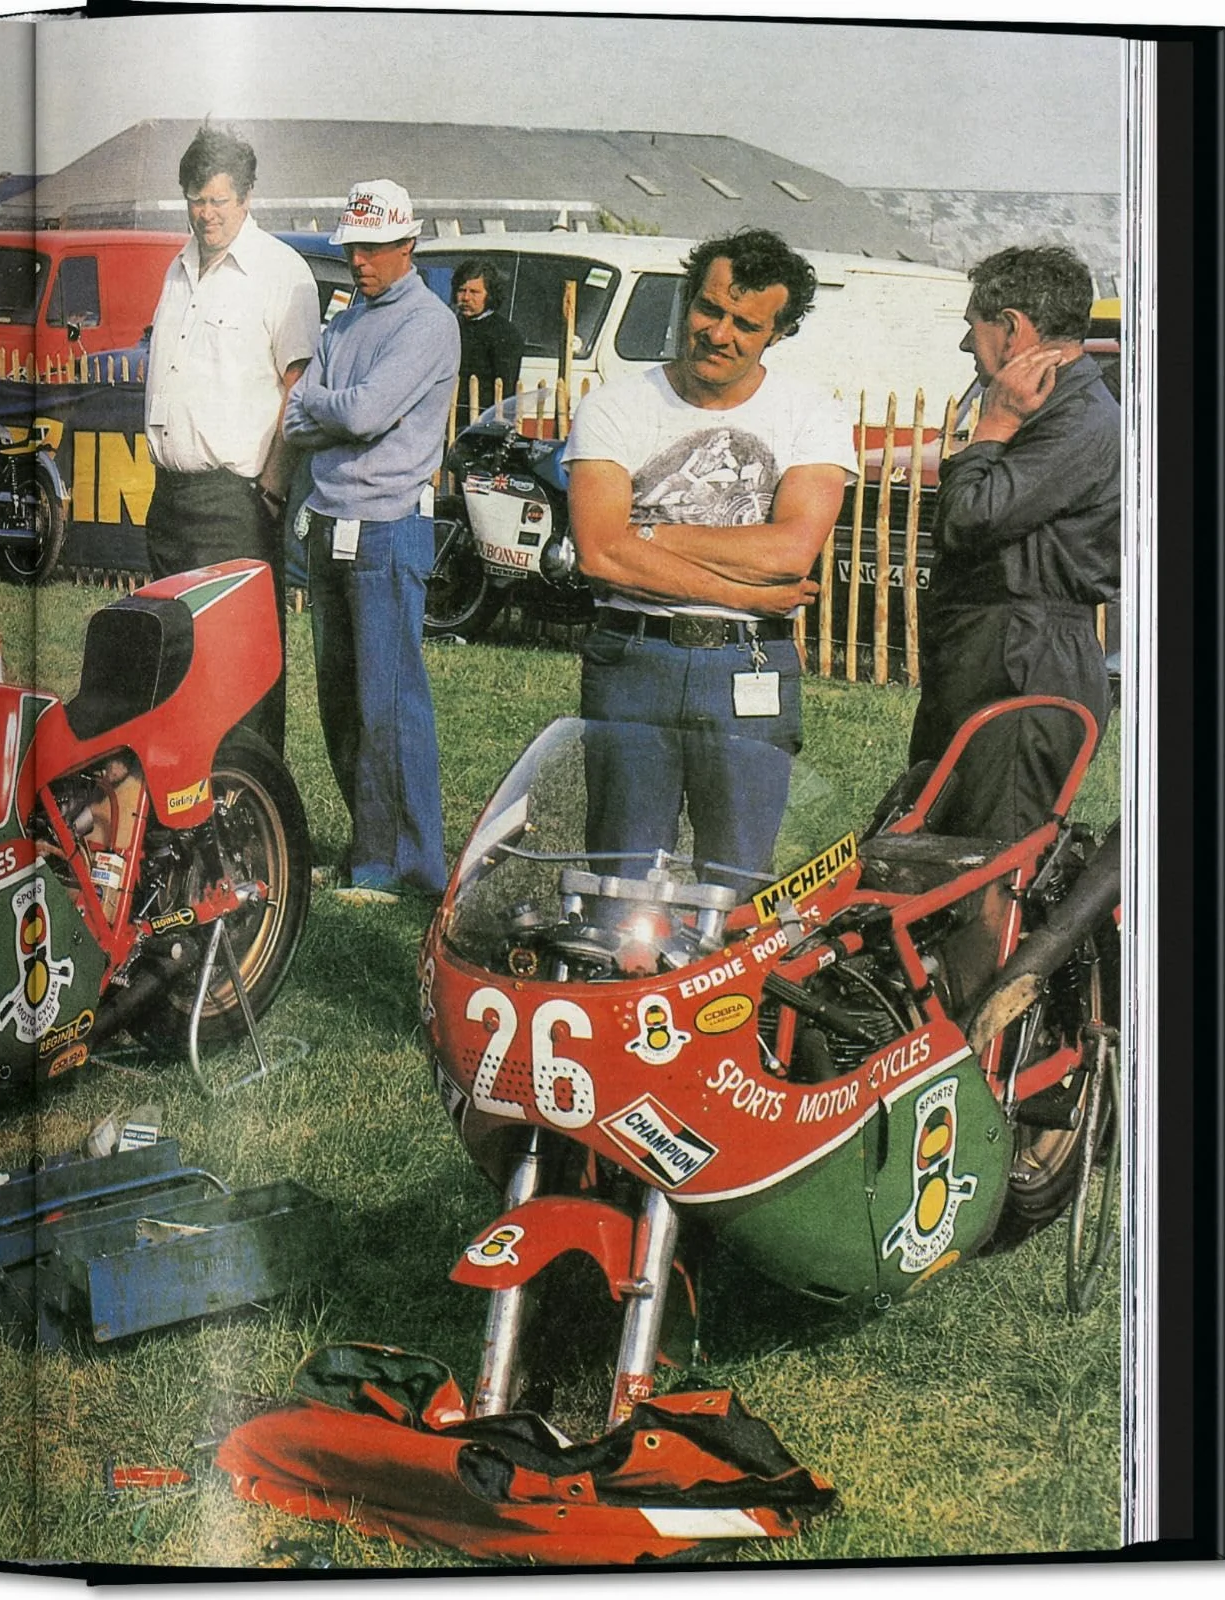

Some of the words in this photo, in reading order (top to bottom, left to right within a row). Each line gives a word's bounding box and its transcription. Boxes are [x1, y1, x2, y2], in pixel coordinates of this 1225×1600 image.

[889, 567, 930, 588] 46
[677, 956, 747, 999] EDDIE
[703, 1003, 745, 1022] COBRA
[39, 1026, 75, 1053] REGINA
[465, 986, 596, 1129] 26
[705, 1057, 787, 1122] SPORTS
[795, 1079, 860, 1124] MOTOR
[868, 1032, 931, 1090] CYCLES
[918, 1084, 954, 1115] SPORTS
[623, 1110, 699, 1176] CHAMPION
